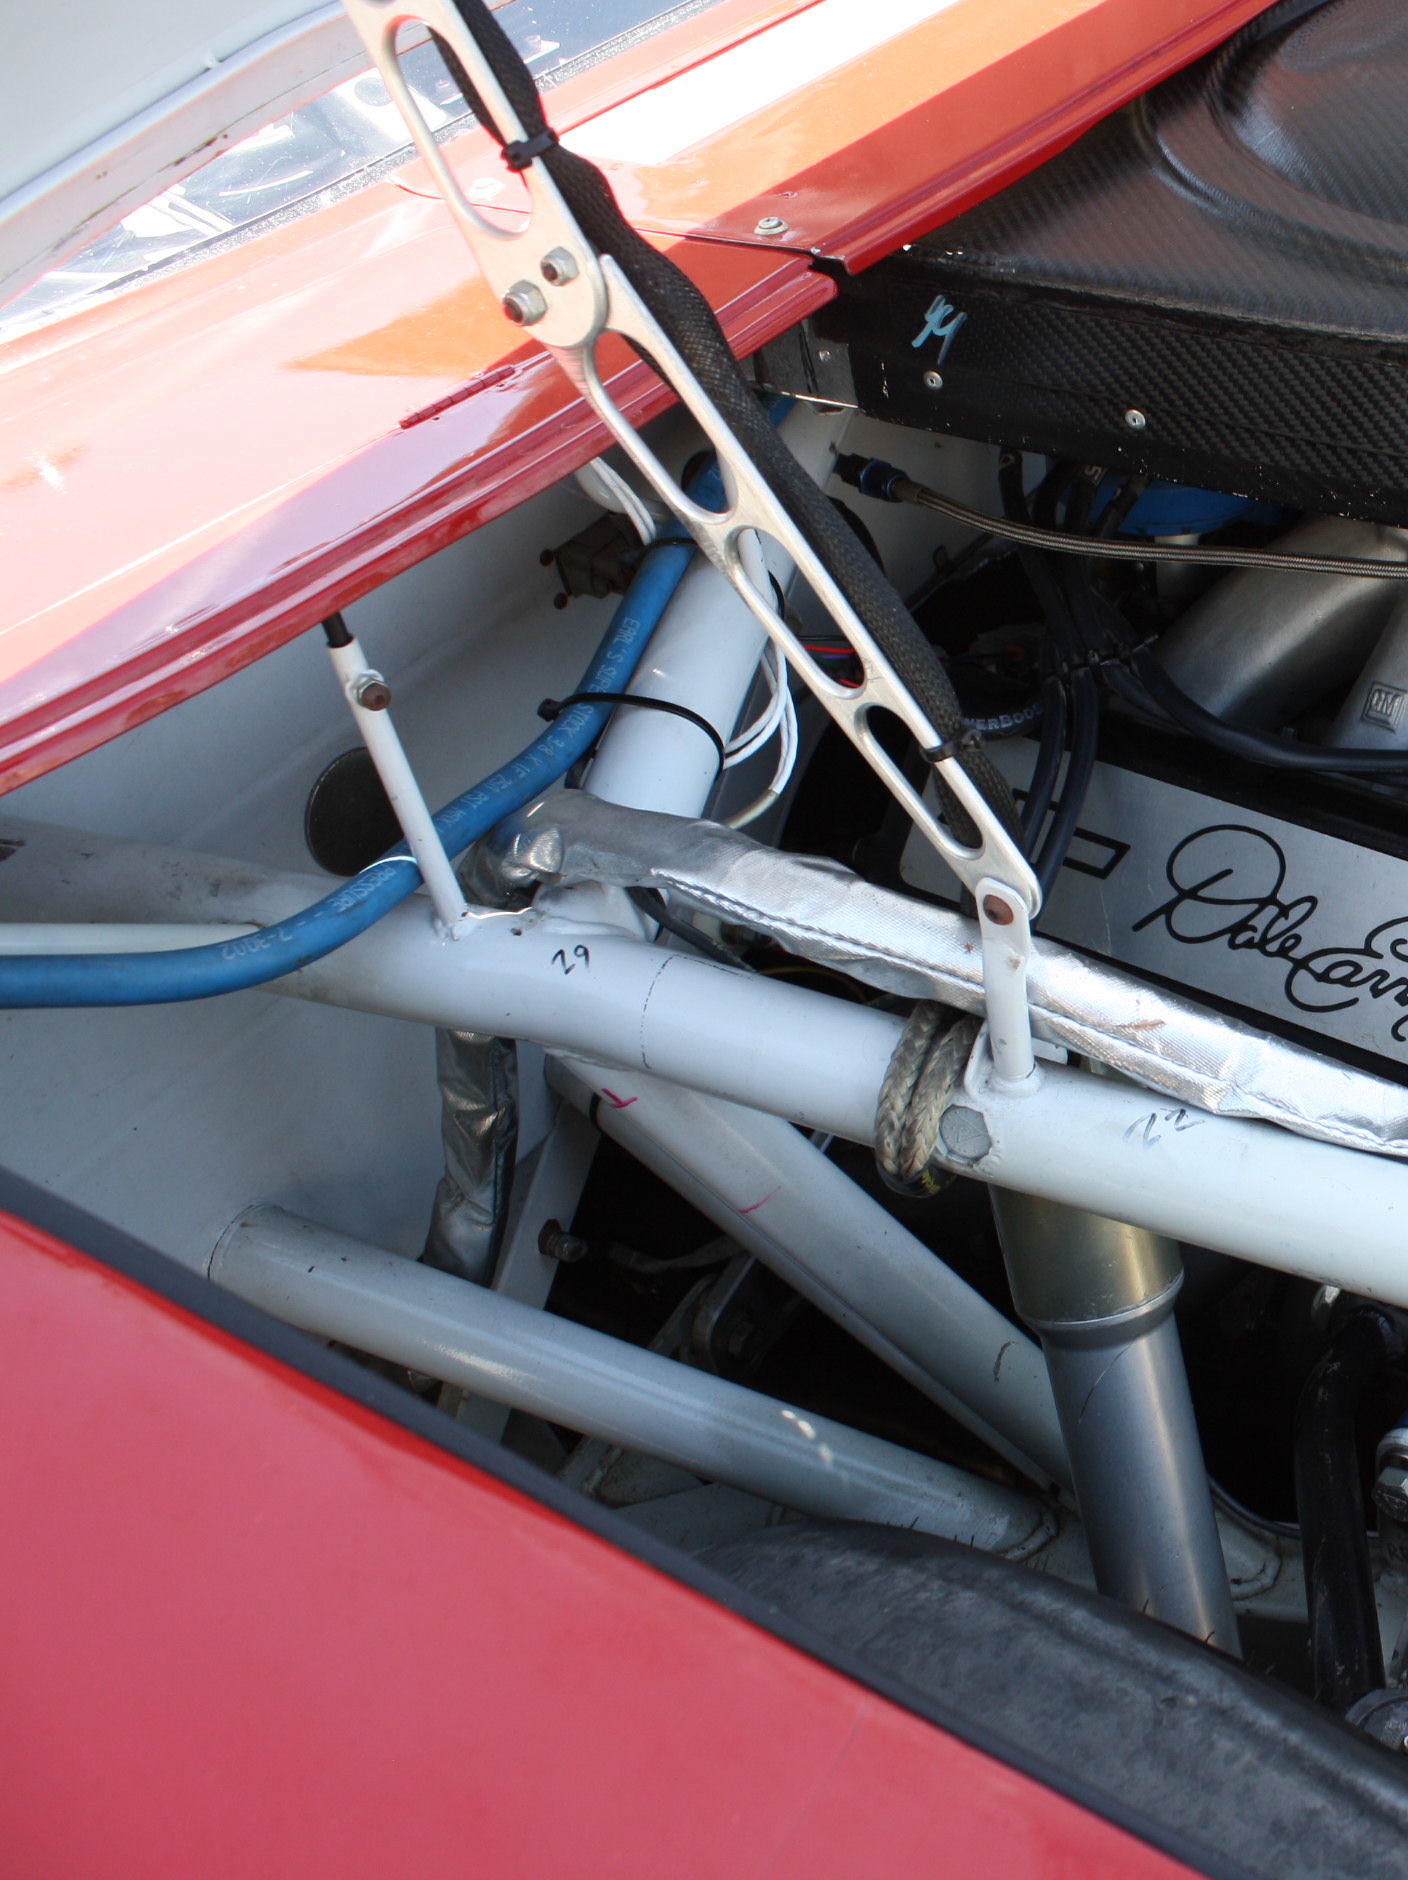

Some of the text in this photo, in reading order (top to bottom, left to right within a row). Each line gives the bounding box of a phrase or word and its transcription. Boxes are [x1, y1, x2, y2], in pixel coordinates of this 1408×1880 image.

[587, 663, 618, 693] SUPE
[558, 702, 595, 738] STOCK
[461, 792, 490, 809] PSI
[326, 863, 397, 912] PRESSURE
[1133, 824, 1318, 964] Dale
